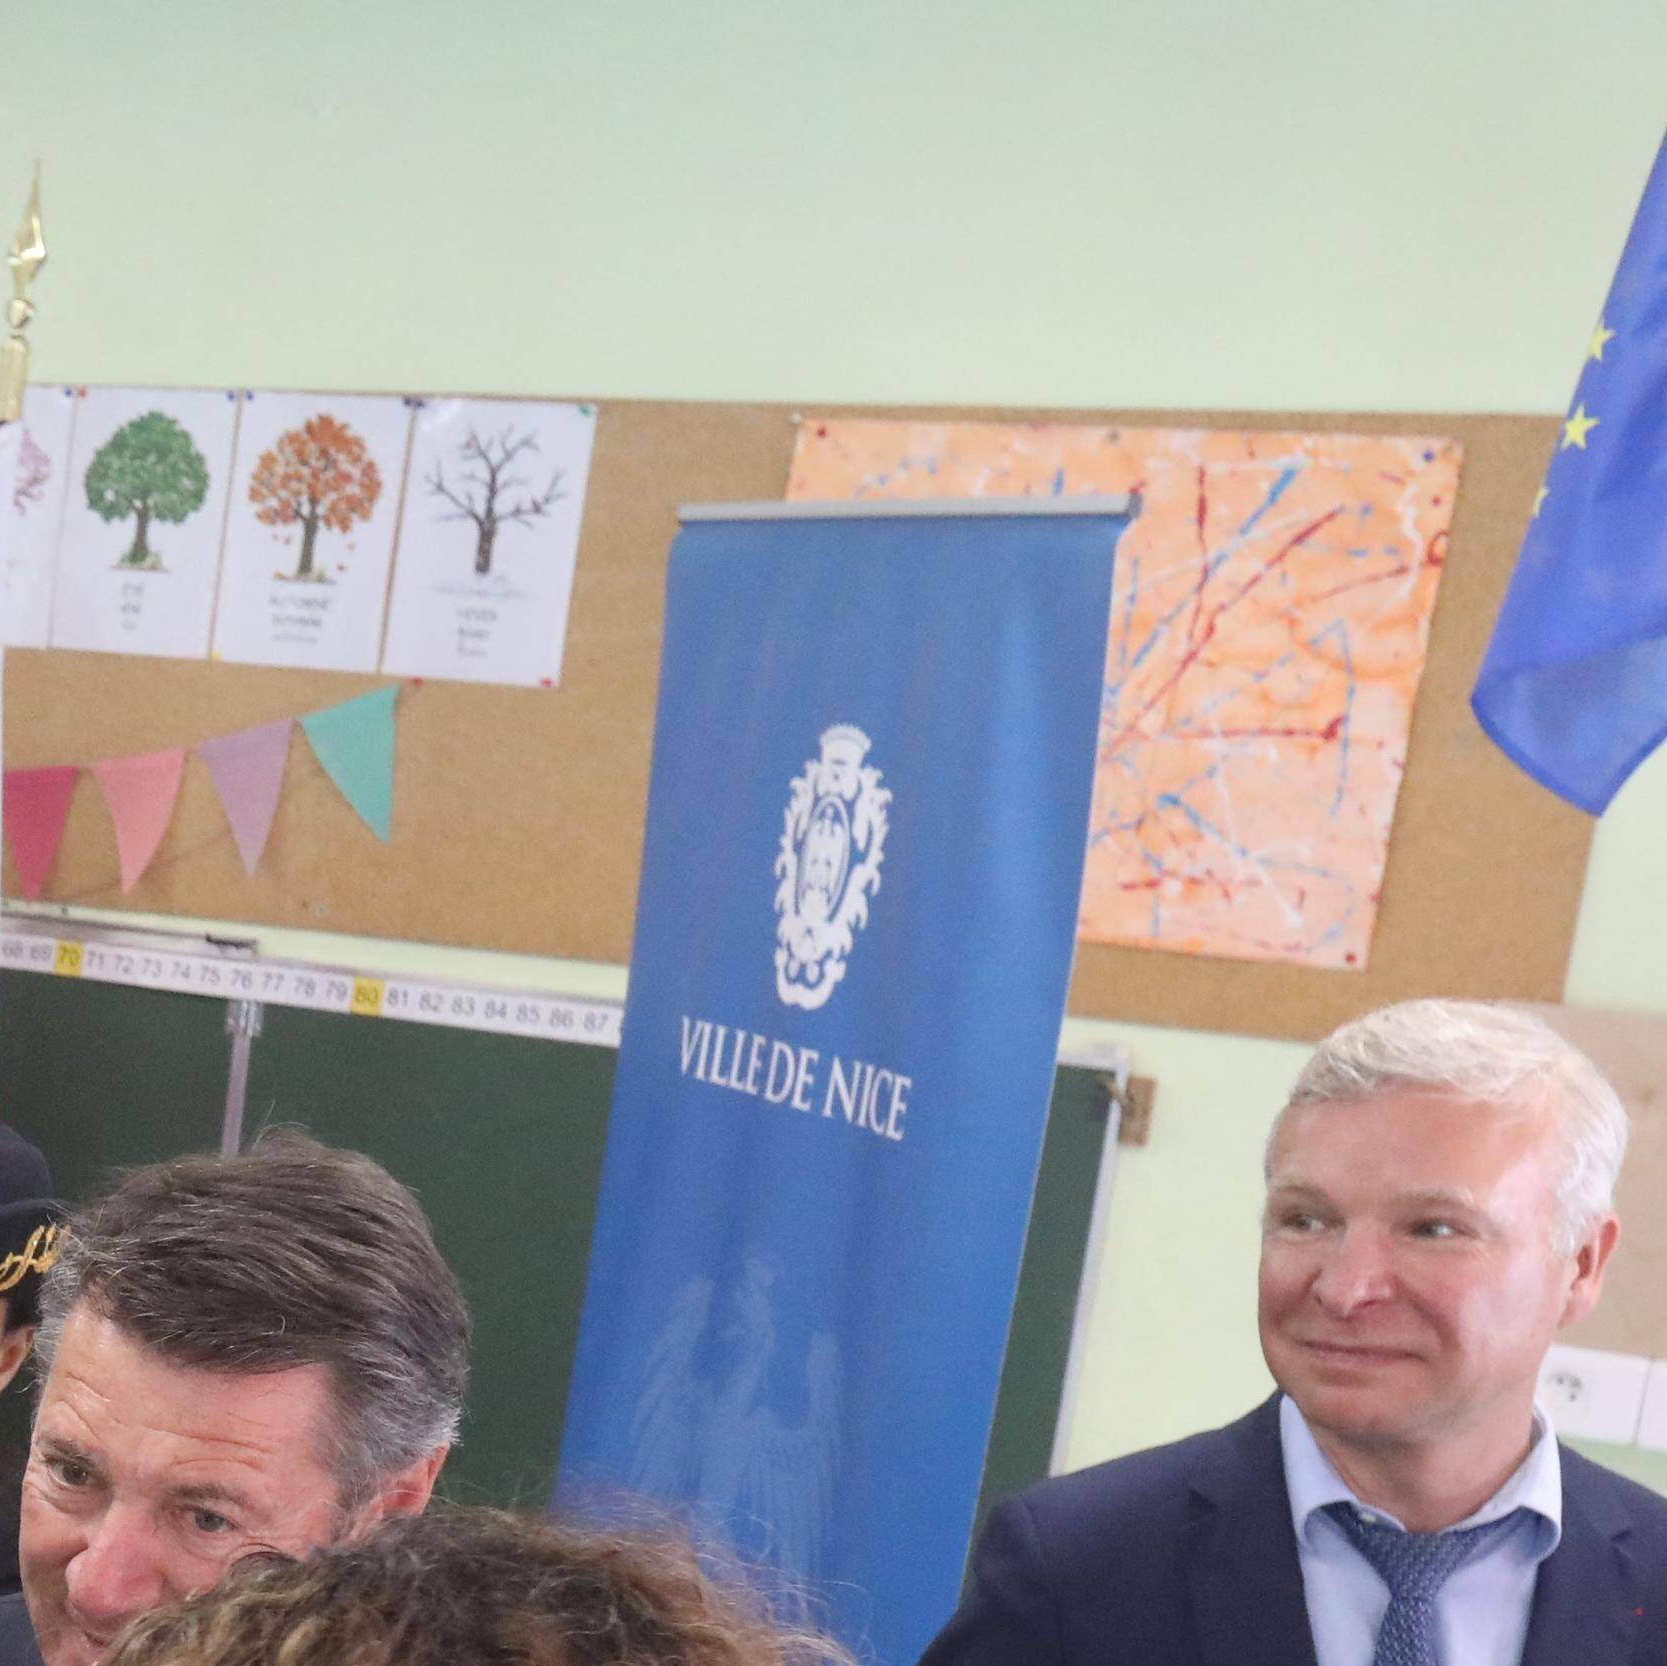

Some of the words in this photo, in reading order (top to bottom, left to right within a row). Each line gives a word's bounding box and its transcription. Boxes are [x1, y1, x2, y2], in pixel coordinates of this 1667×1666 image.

[58, 945, 80, 966] 70
[87, 950, 104, 968] 71
[114, 954, 134, 973] 72
[142, 958, 162, 977] 73
[171, 961, 190, 980] 74
[200, 965, 220, 986] 75
[230, 968, 253, 988] 76
[262, 972, 285, 992] 77
[293, 975, 315, 998] 78
[325, 980, 348, 1001] 79
[354, 984, 378, 1005] 80
[387, 987, 409, 1008] 81
[419, 990, 444, 1012] 82
[451, 994, 475, 1016] 83
[485, 998, 507, 1019] 84
[517, 1001, 540, 1024] 85
[550, 1006, 574, 1028] 86
[584, 1010, 608, 1032] 87
[680, 1015, 767, 1095] VILLE
[764, 1040, 819, 1112] DE
[822, 1056, 912, 1141] NICE
